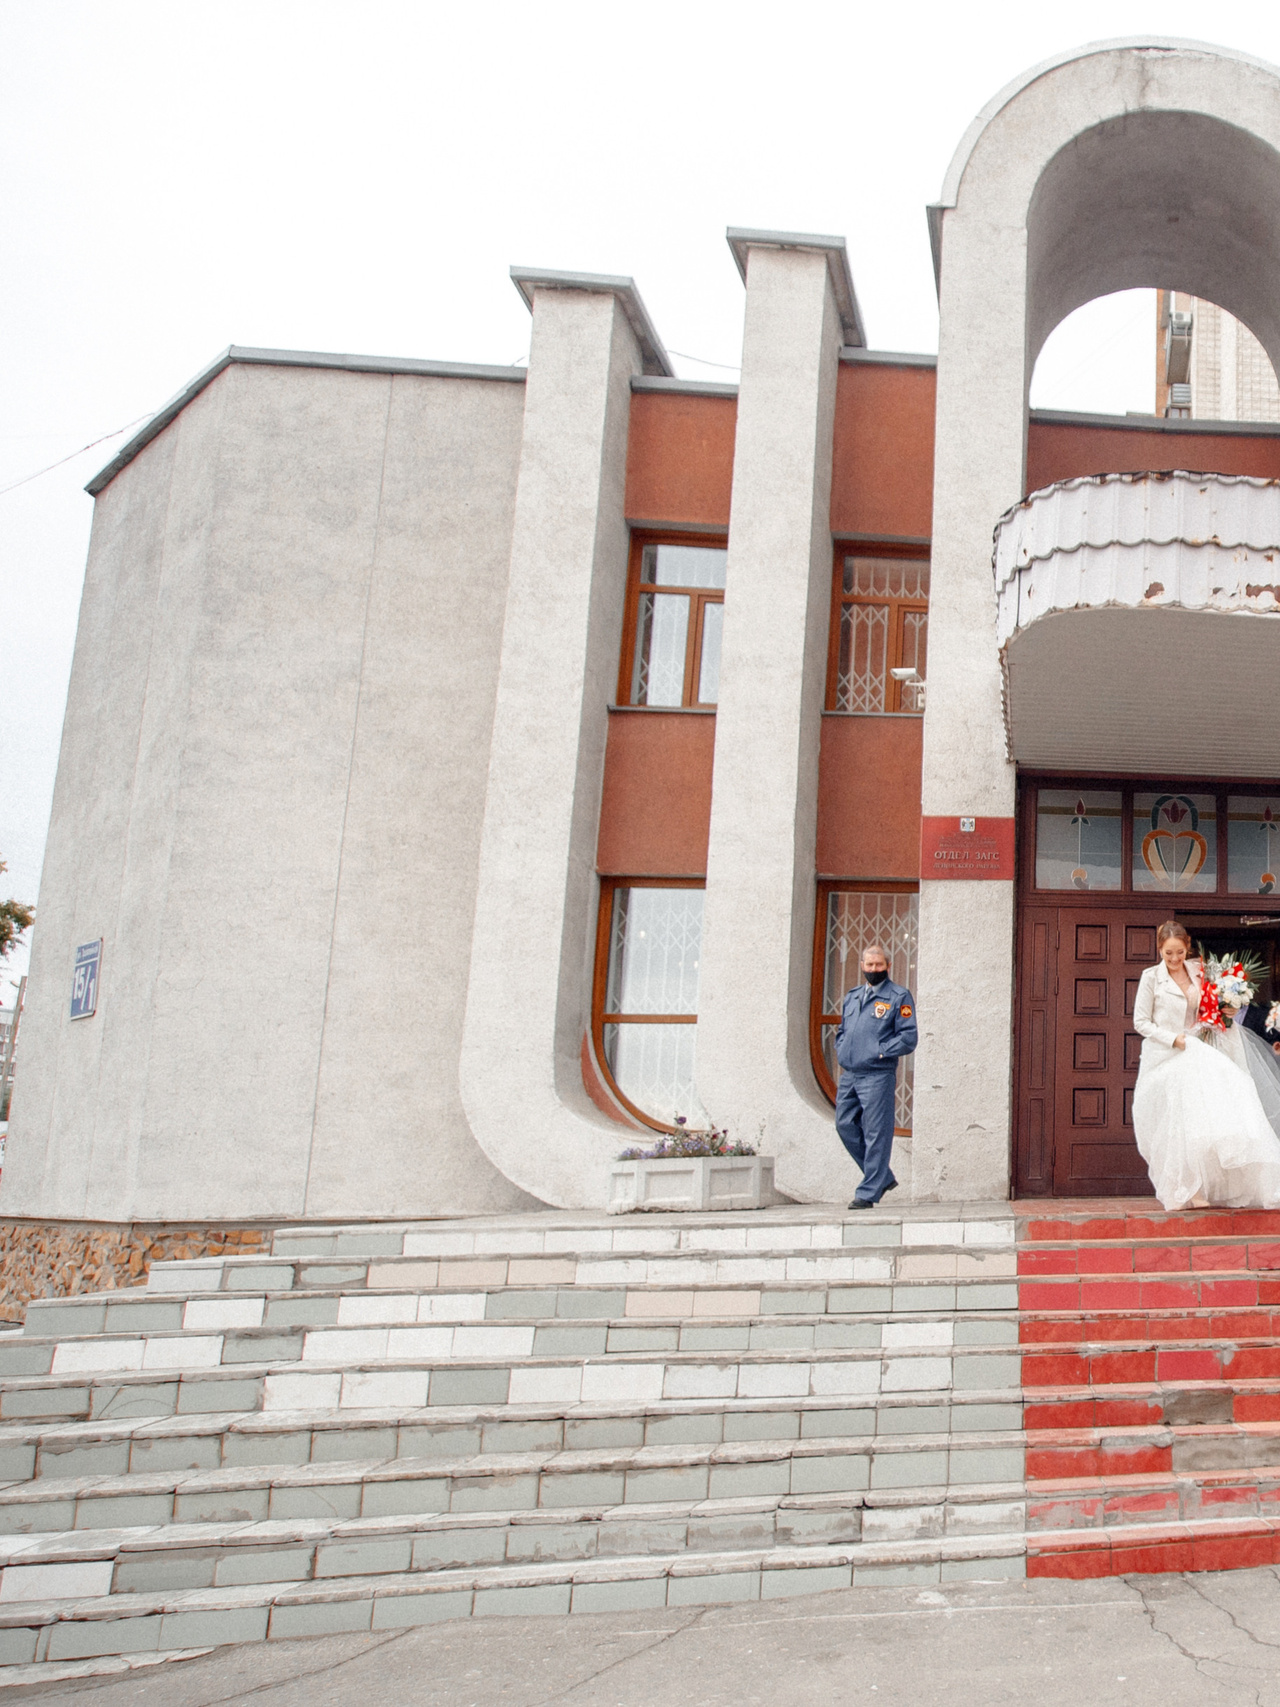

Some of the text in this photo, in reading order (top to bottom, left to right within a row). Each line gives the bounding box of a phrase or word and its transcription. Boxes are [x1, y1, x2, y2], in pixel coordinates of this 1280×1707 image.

[934, 850, 1000, 861] ОТДЕЛ ЗАГС
[73, 965, 95, 1011] 15/1
